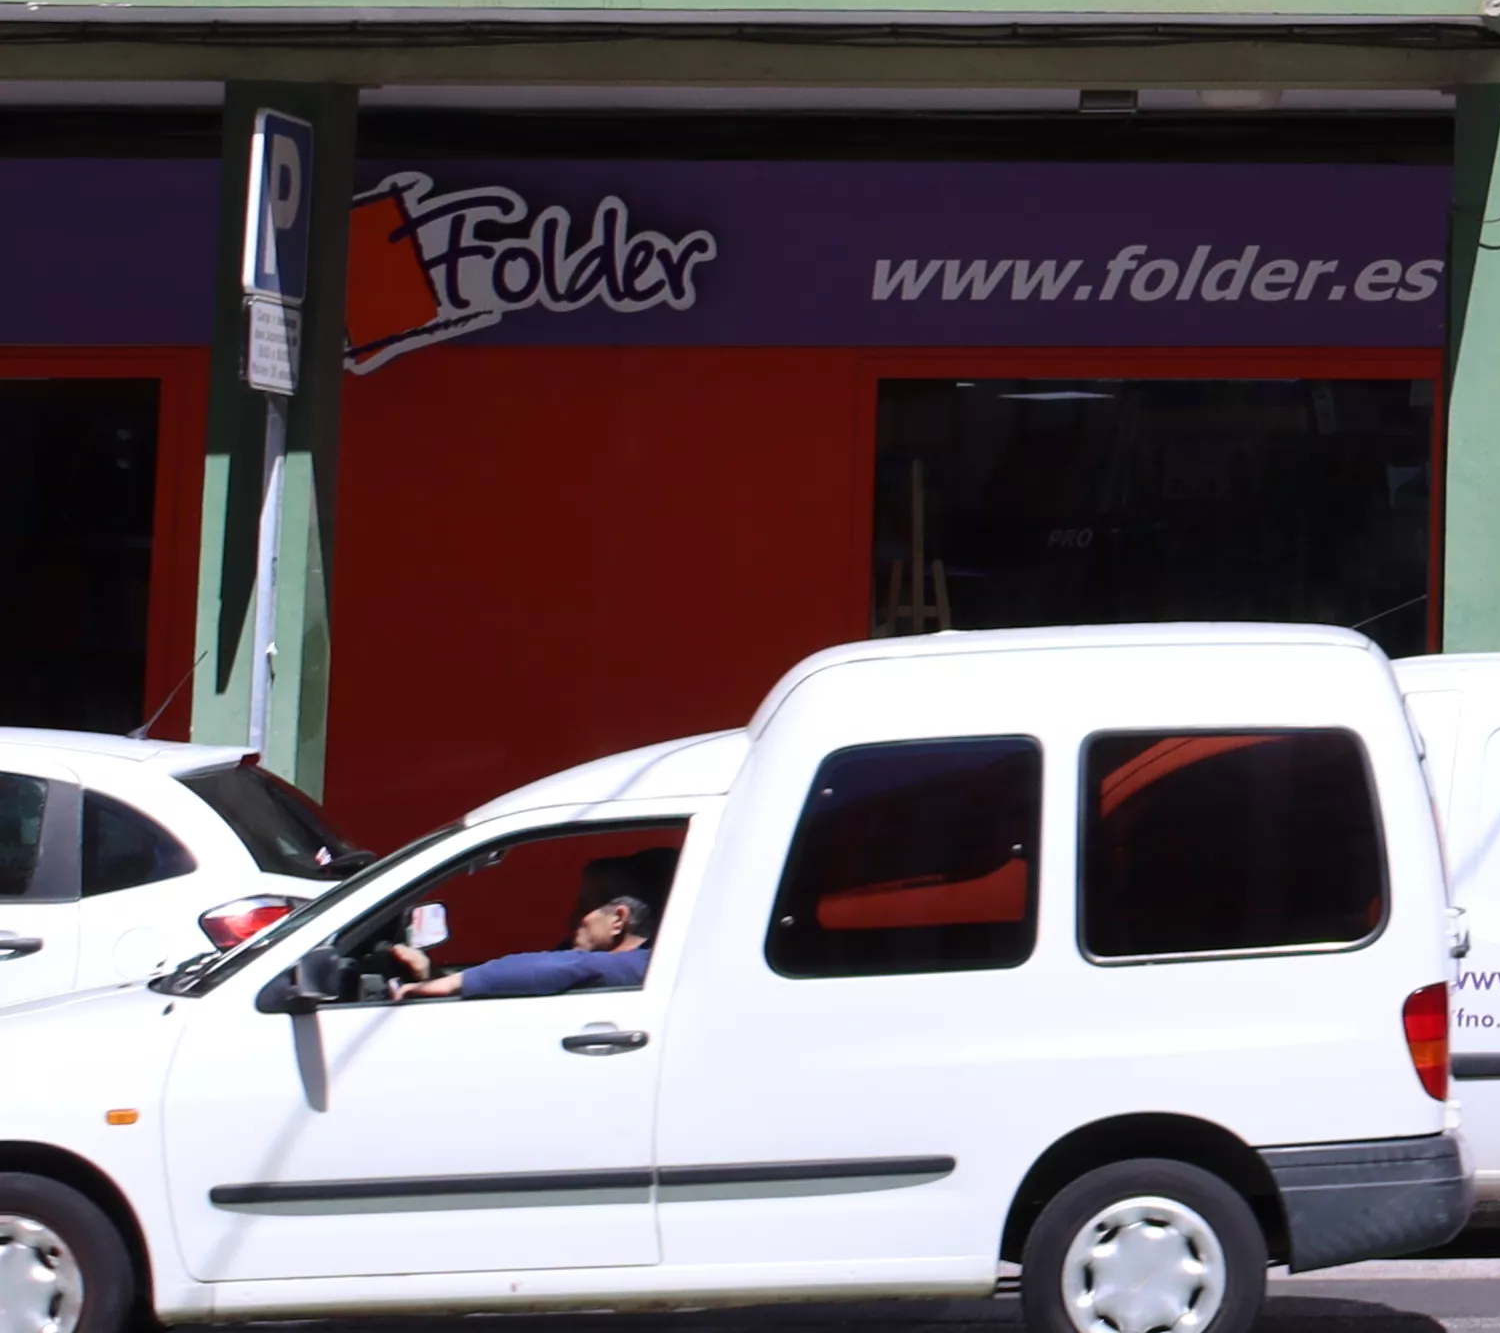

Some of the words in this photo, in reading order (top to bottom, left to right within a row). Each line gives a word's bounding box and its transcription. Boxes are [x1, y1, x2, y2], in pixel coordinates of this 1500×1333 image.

[263, 133, 301, 275] P
[389, 195, 708, 311] Folder
[871, 245, 1444, 303] www.folder.es
[1048, 528, 1093, 547] PRO
